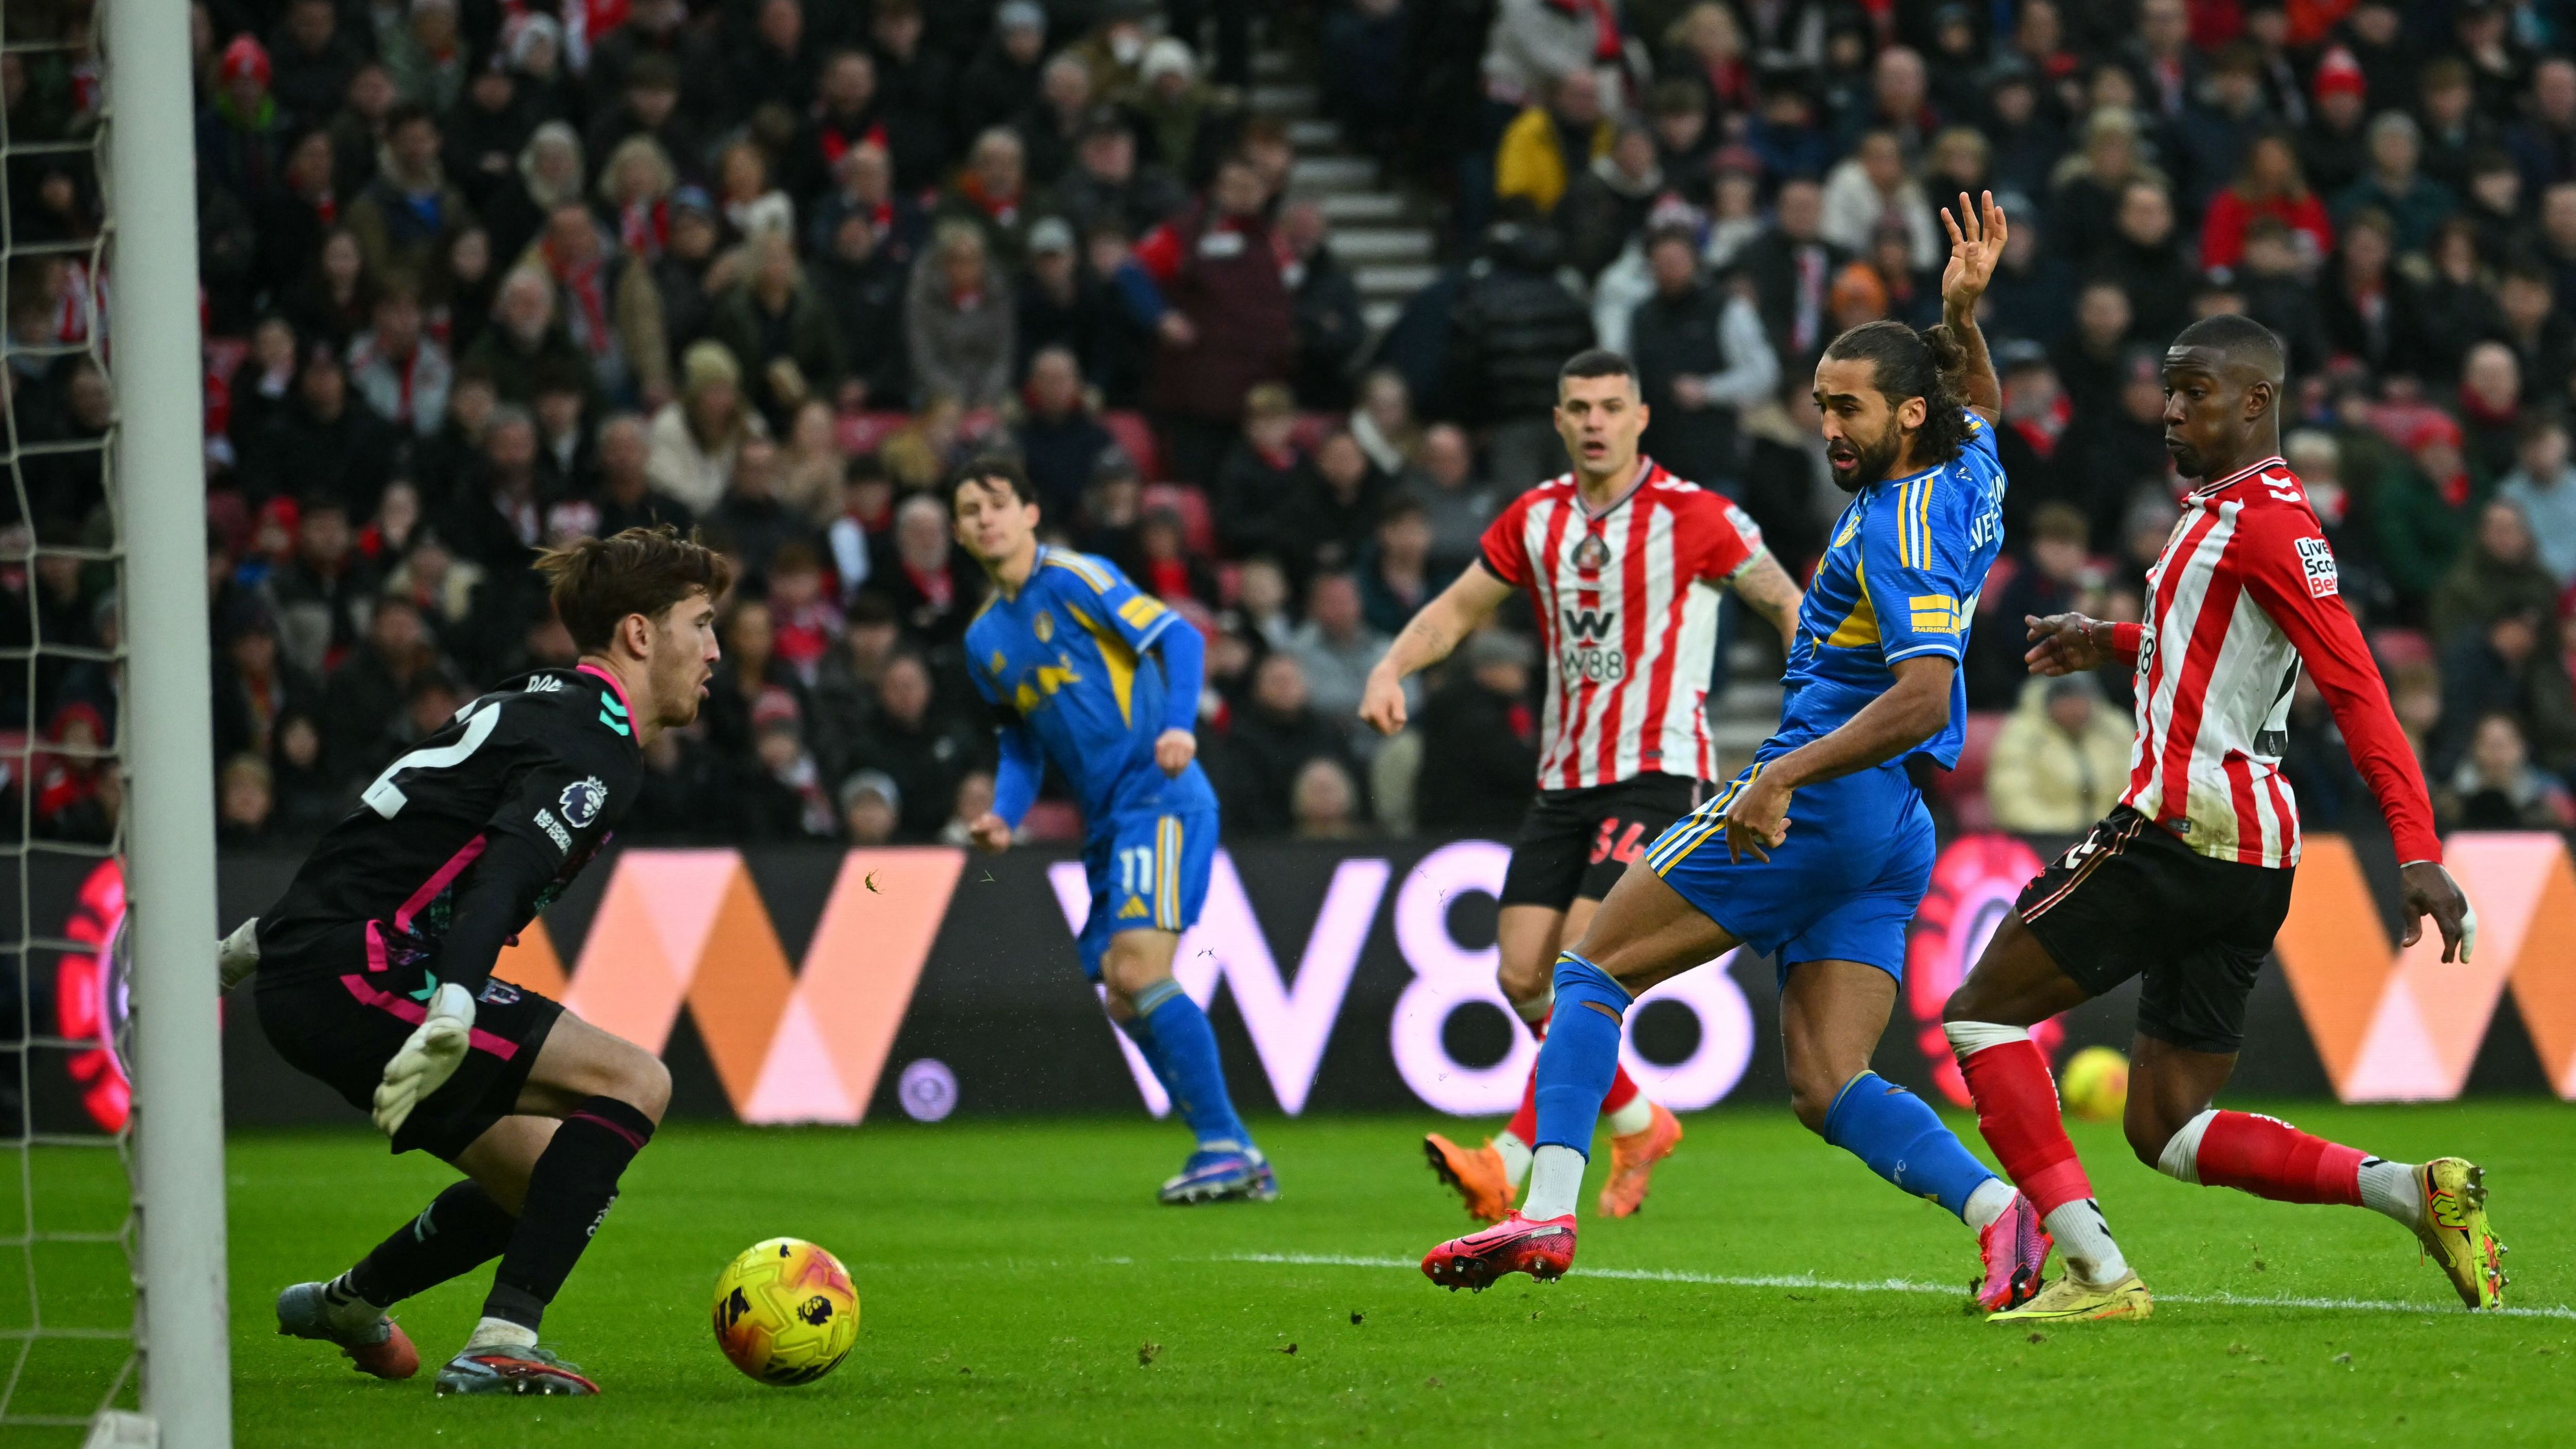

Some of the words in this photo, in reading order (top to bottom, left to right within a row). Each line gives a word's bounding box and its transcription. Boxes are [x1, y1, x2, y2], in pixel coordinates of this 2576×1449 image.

[2297, 539, 2329, 556] Live
[2305, 558, 2336, 576] Sco
[1563, 610, 1615, 639] W
[1912, 626, 1960, 639] PARIMAT
[1560, 650, 1623, 678] W88
[360, 695, 501, 820] 2
[1590, 817, 1646, 865] 34
[1120, 846, 1153, 895] 11
[1046, 839, 1752, 1117] W88
